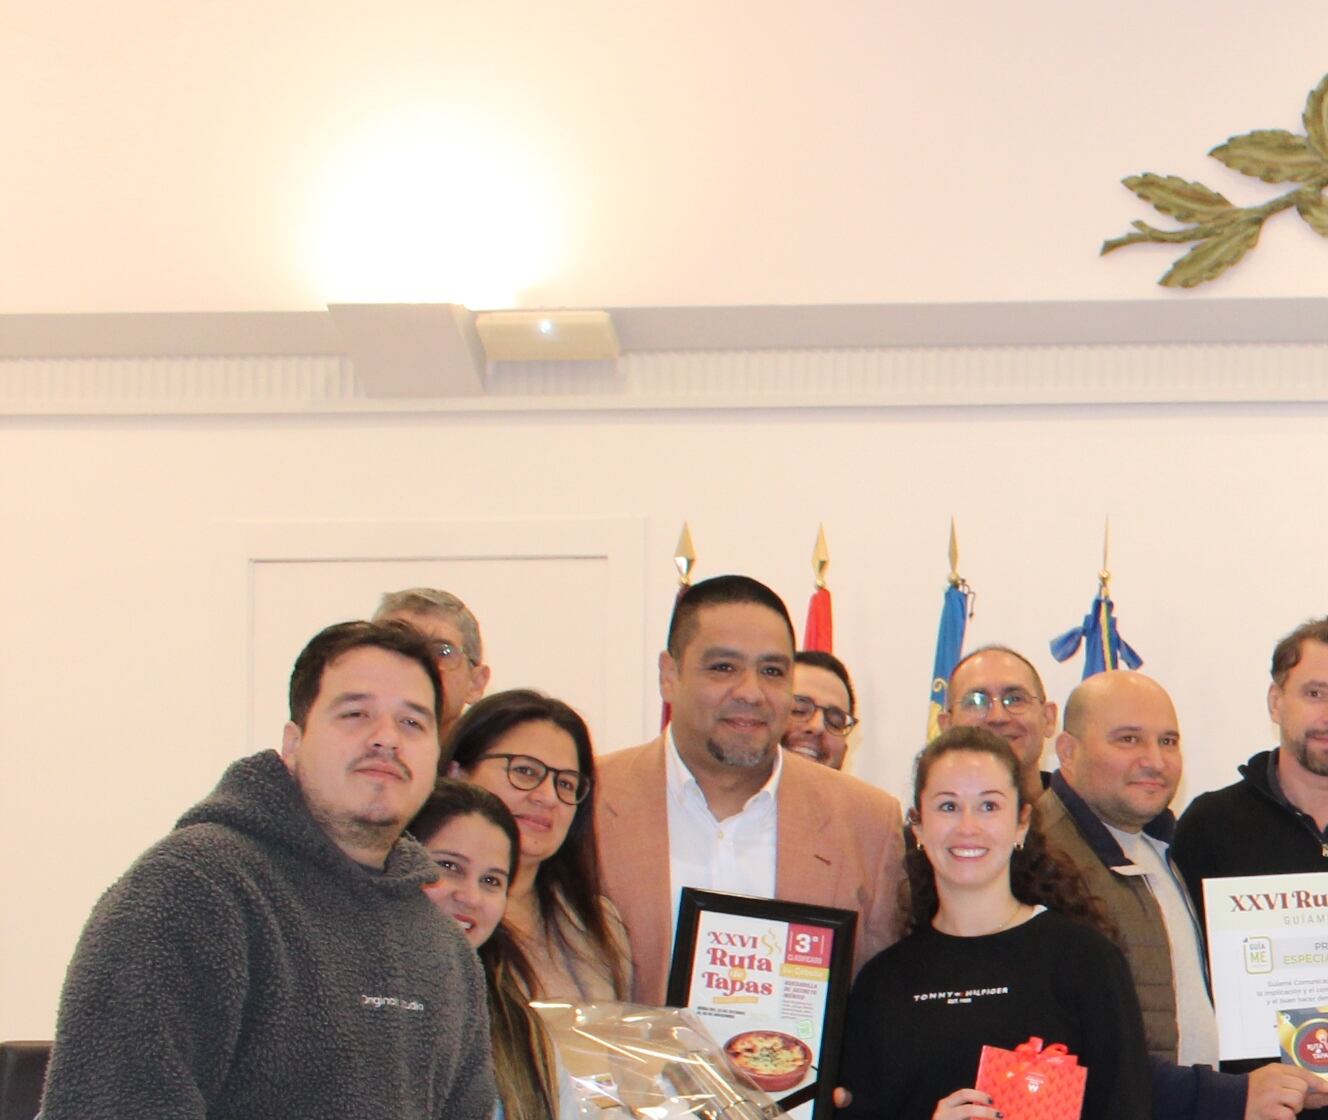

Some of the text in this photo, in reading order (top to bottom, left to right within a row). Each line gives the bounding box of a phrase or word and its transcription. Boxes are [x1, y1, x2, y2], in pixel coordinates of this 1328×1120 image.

[1230, 893, 1288, 912] XXVI
[707, 931, 759, 949] XXVI
[706, 947, 773, 973] Ruta
[1250, 951, 1267, 963] ME
[702, 971, 773, 996] Tapas
